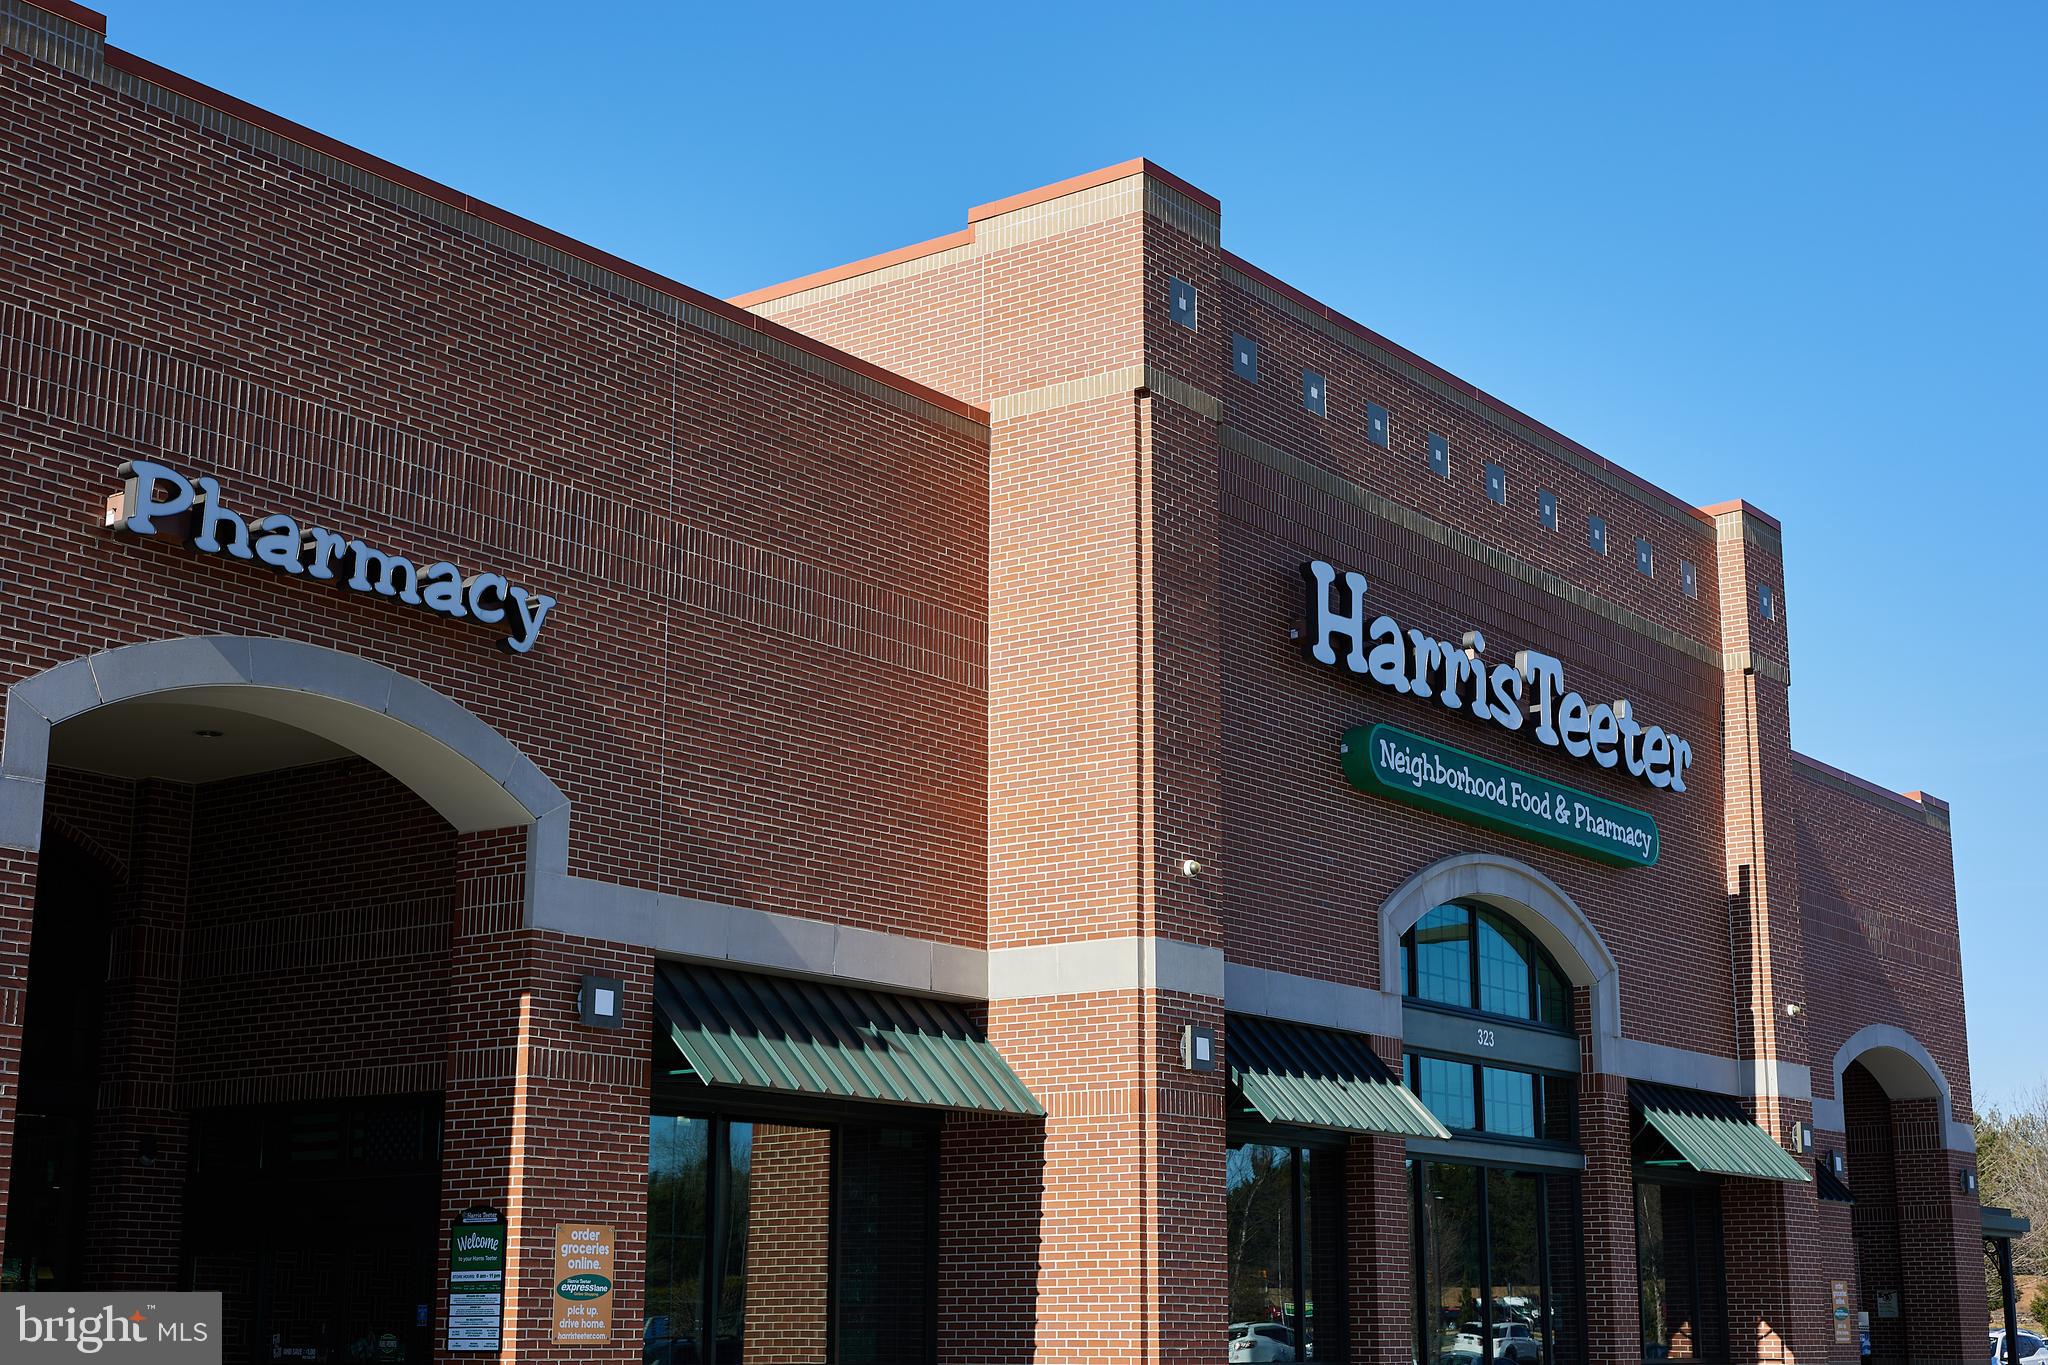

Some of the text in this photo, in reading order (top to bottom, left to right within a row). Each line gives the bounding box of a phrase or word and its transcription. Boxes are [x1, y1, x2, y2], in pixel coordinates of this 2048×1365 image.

[126, 459, 557, 654] Pharmacy
[1310, 560, 1693, 793] Harris Teeter
[1379, 739, 1652, 858] Neighborhood Food & Pharmacy
[1477, 1028, 1495, 1047] 323
[457, 1232, 499, 1251] Welcome
[571, 1228, 600, 1241] order
[561, 1242, 610, 1257] groceries
[568, 1256, 601, 1270] online.
[567, 1304, 599, 1317] pick up.
[559, 1318, 606, 1329] drive home.
